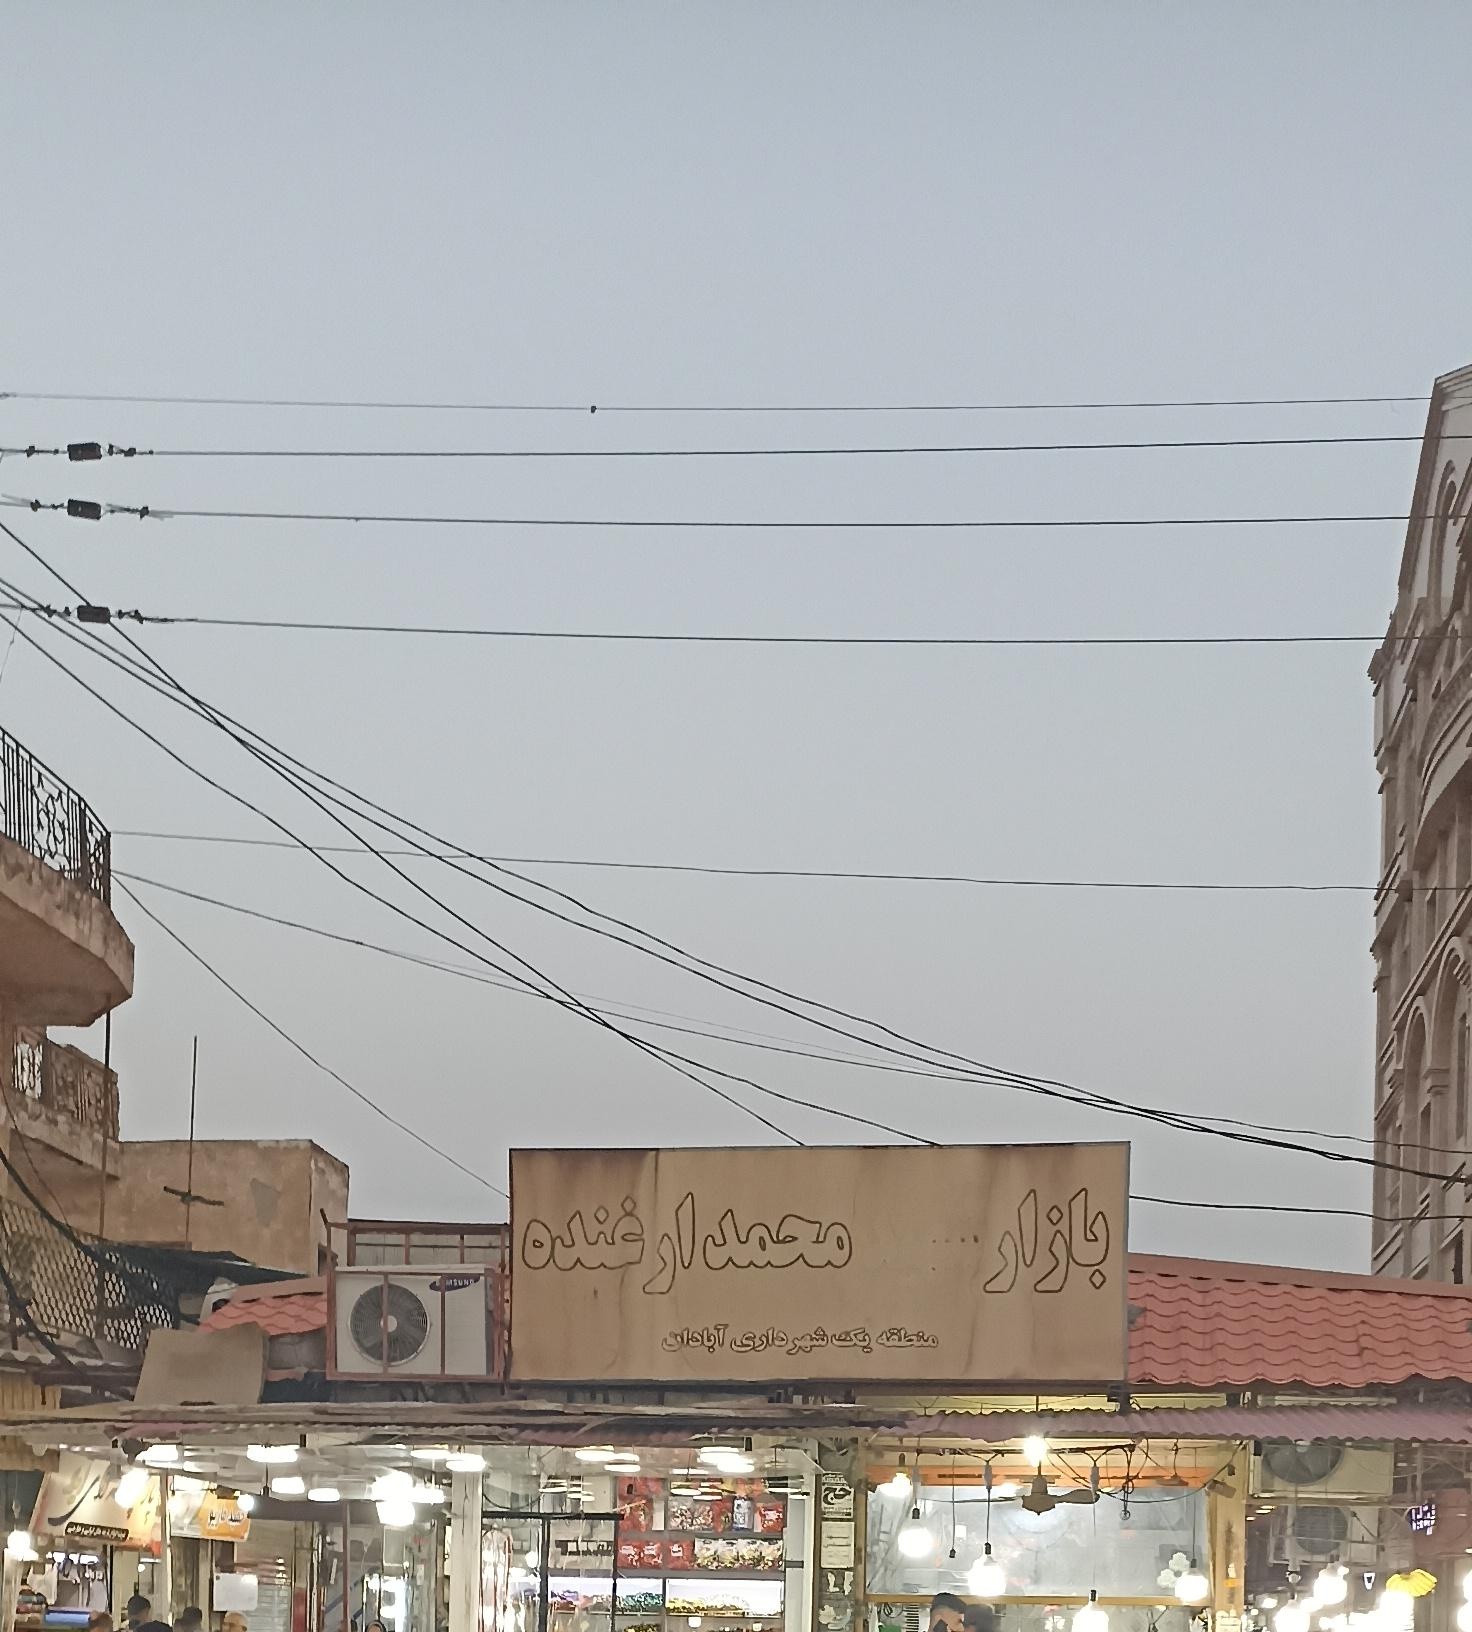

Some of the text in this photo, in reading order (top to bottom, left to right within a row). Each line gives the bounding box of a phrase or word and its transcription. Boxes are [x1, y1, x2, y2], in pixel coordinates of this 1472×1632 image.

[983, 1188, 1110, 1294] بازار
[435, 1278, 474, 1287] SMSUNG
[661, 1323, 730, 1353] آبادان
[830, 1327, 872, 1354] یک
[875, 1327, 939, 1349] منطقه
